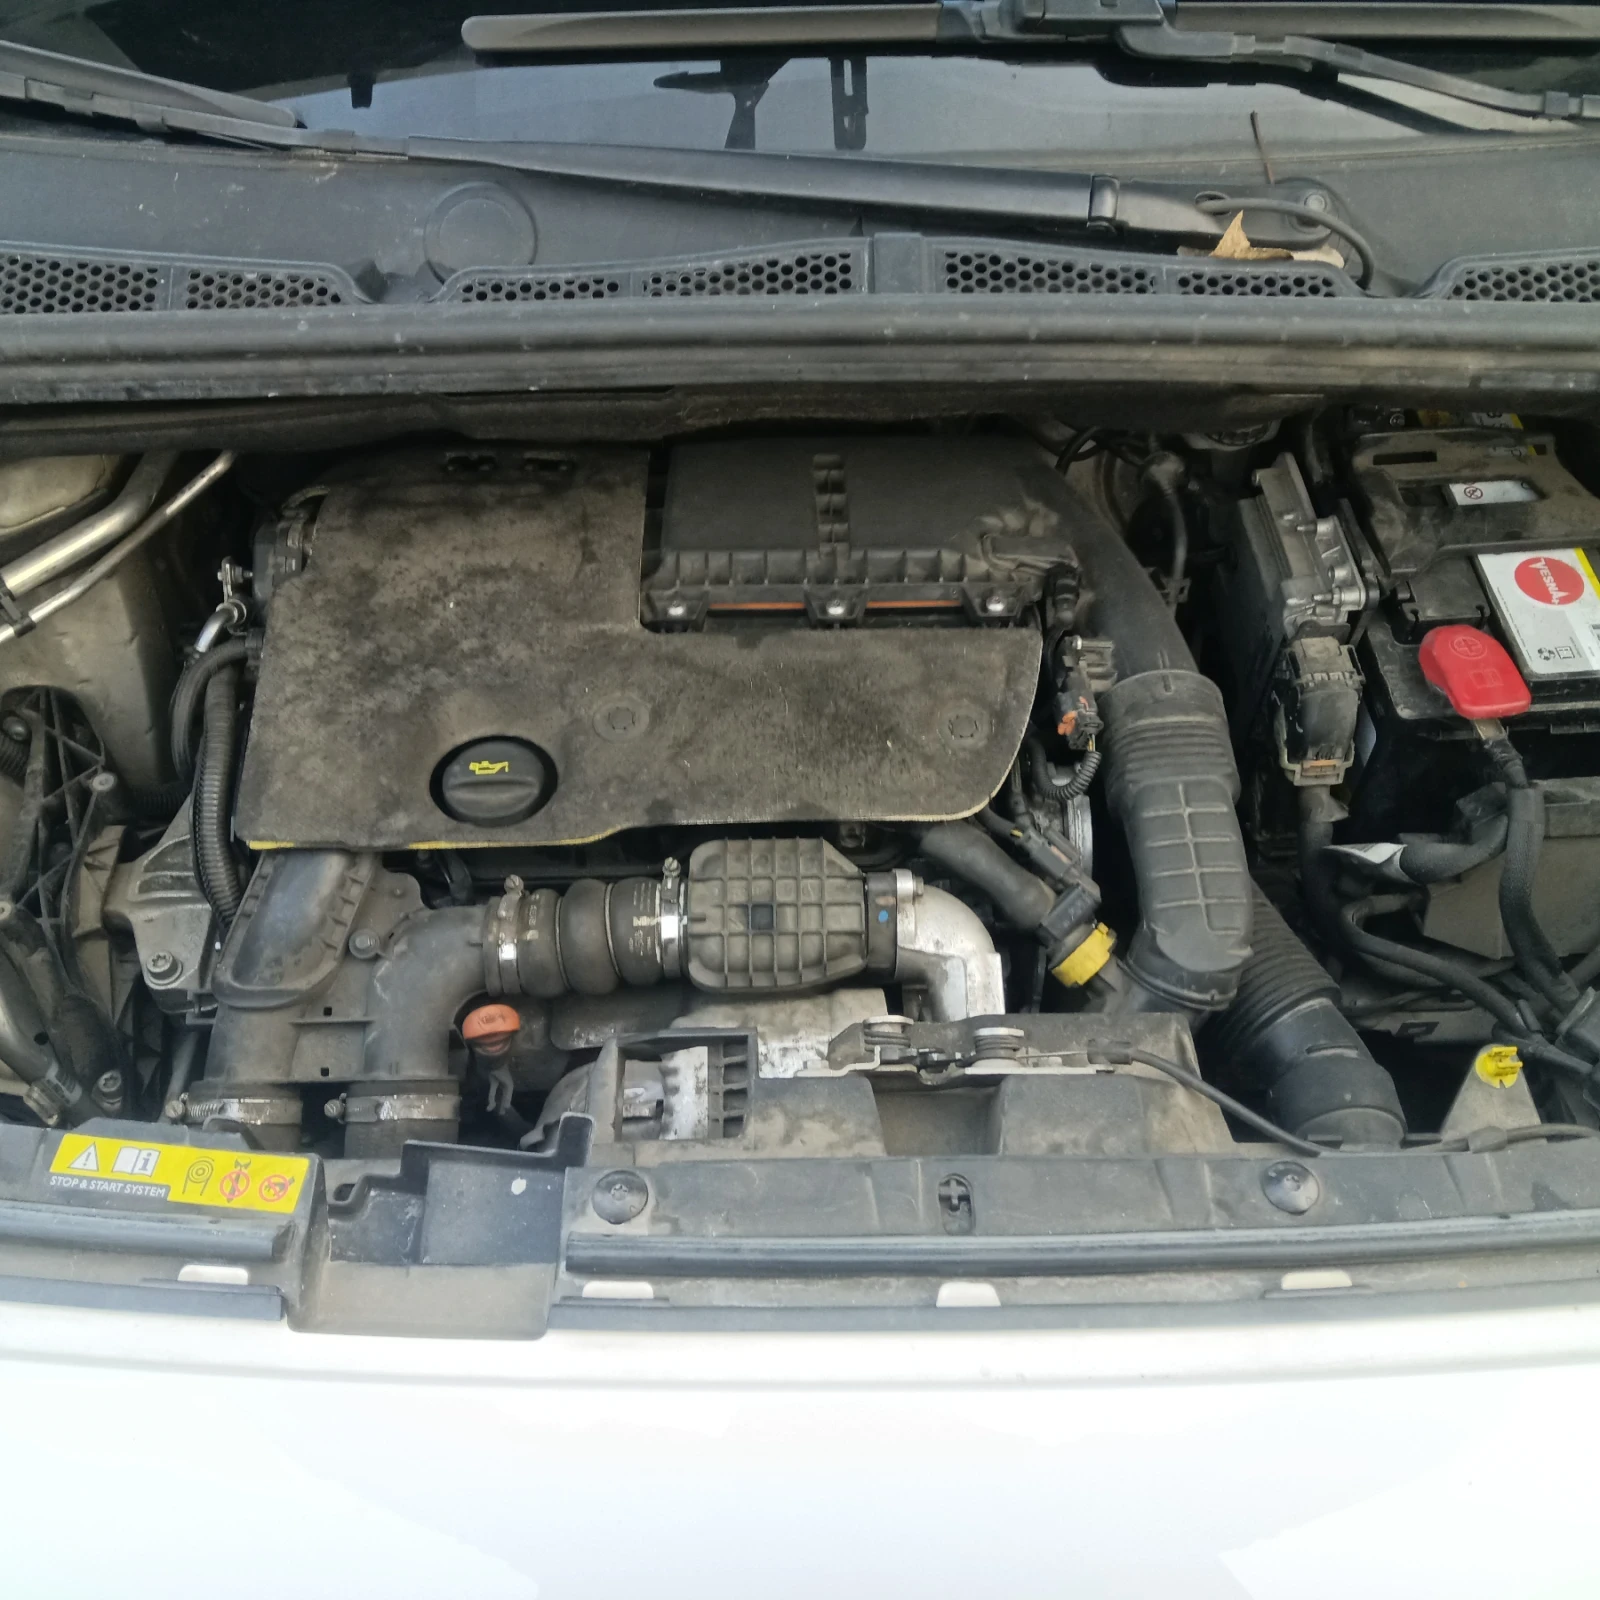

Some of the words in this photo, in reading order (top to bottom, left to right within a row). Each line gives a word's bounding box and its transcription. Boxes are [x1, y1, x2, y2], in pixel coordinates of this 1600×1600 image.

[50, 1175, 79, 1187] STOP
[80, 1179, 87, 1189] &
[89, 1180, 123, 1193] START
[124, 1184, 166, 1197] SYSTEM
